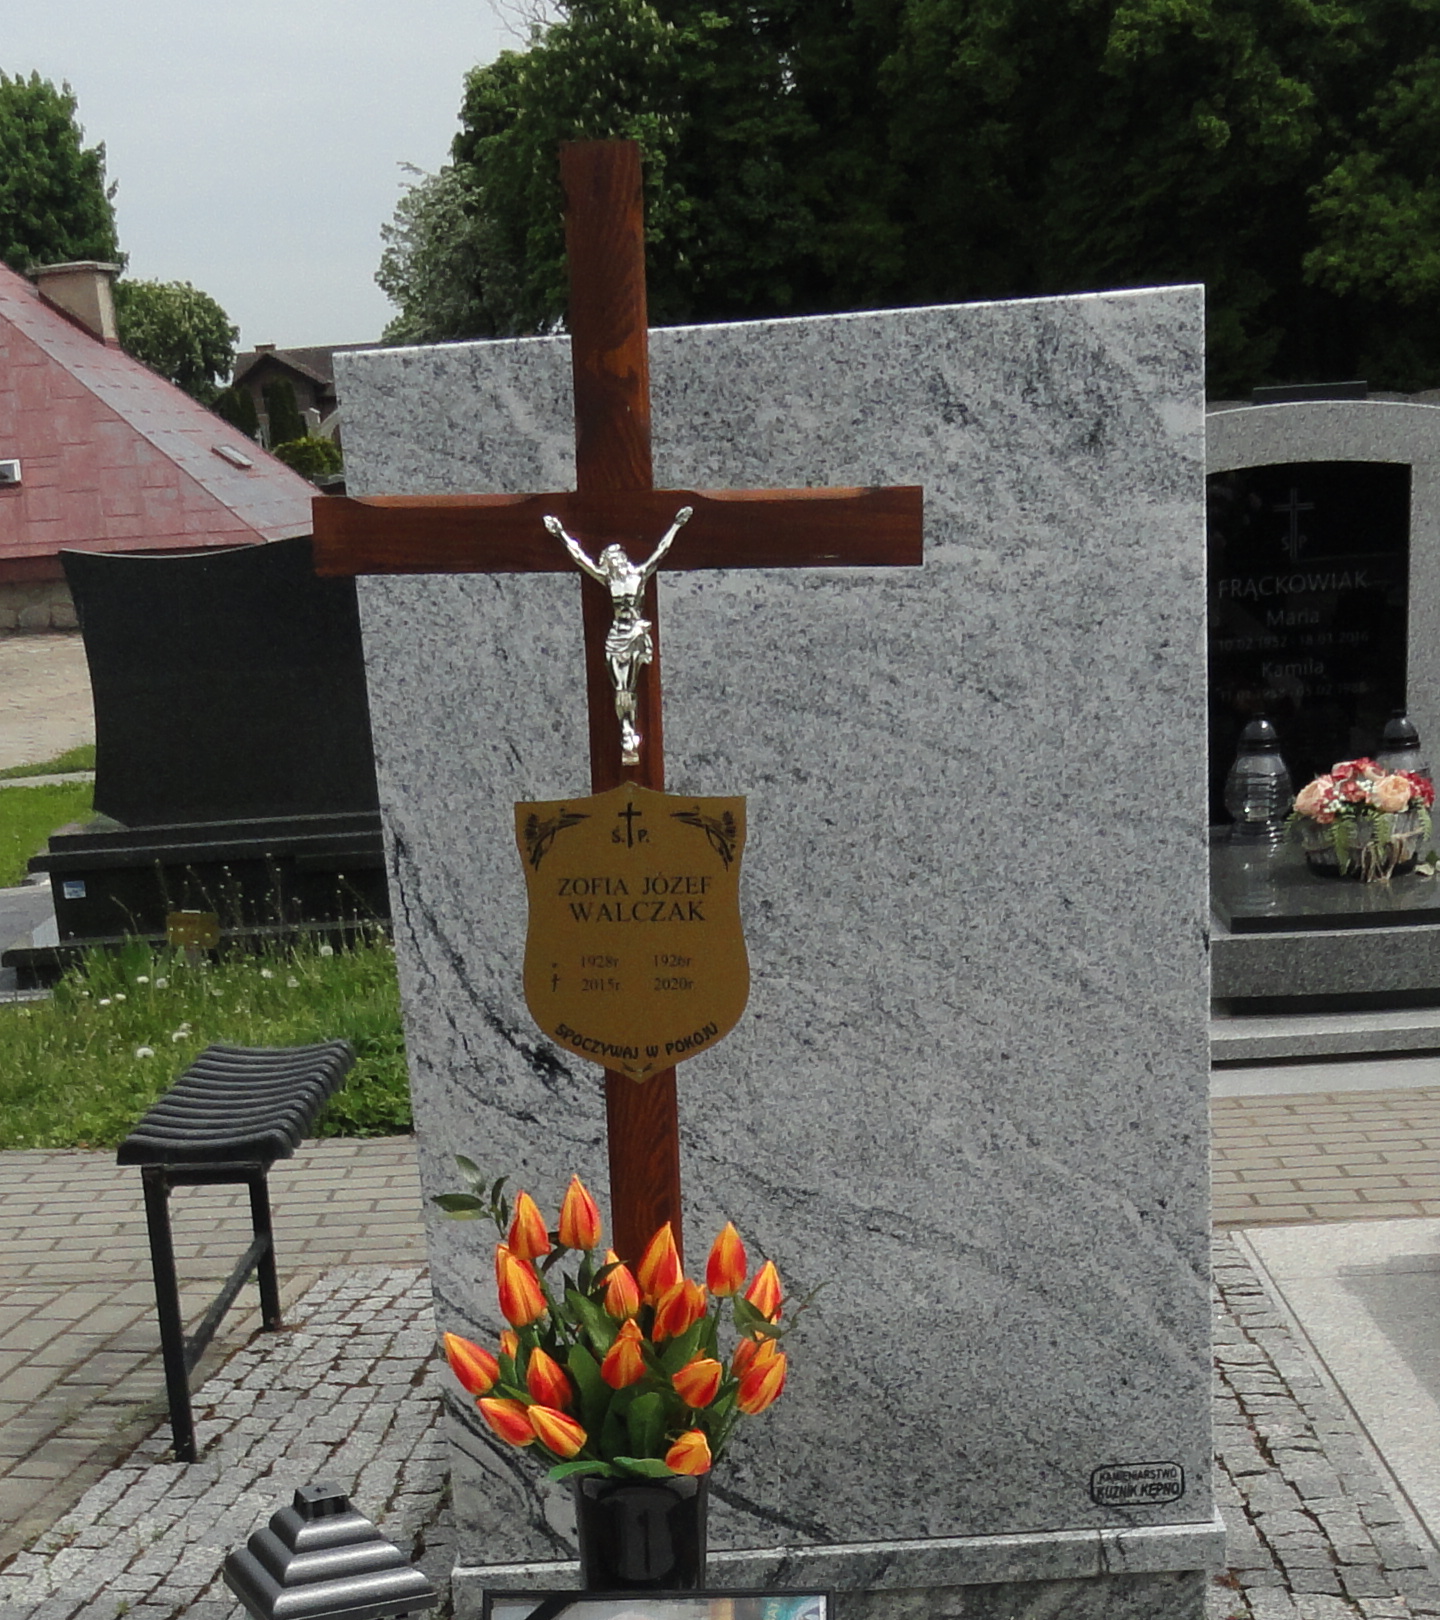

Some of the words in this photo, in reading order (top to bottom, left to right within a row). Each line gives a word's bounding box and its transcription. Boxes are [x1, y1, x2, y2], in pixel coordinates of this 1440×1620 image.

[1218, 569, 1368, 602] FRĄCKOWIAK
[1266, 605, 1320, 627] Maria
[1261, 657, 1324, 678] Kamila
[558, 877, 629, 896] ZOFIA
[642, 871, 712, 896] JÓZEF
[569, 900, 706, 923] WALCZAK
[555, 1023, 639, 1060] SPOCZYWAJ
[646, 1044, 659, 1058] W
[665, 1021, 719, 1056] POKOJU
